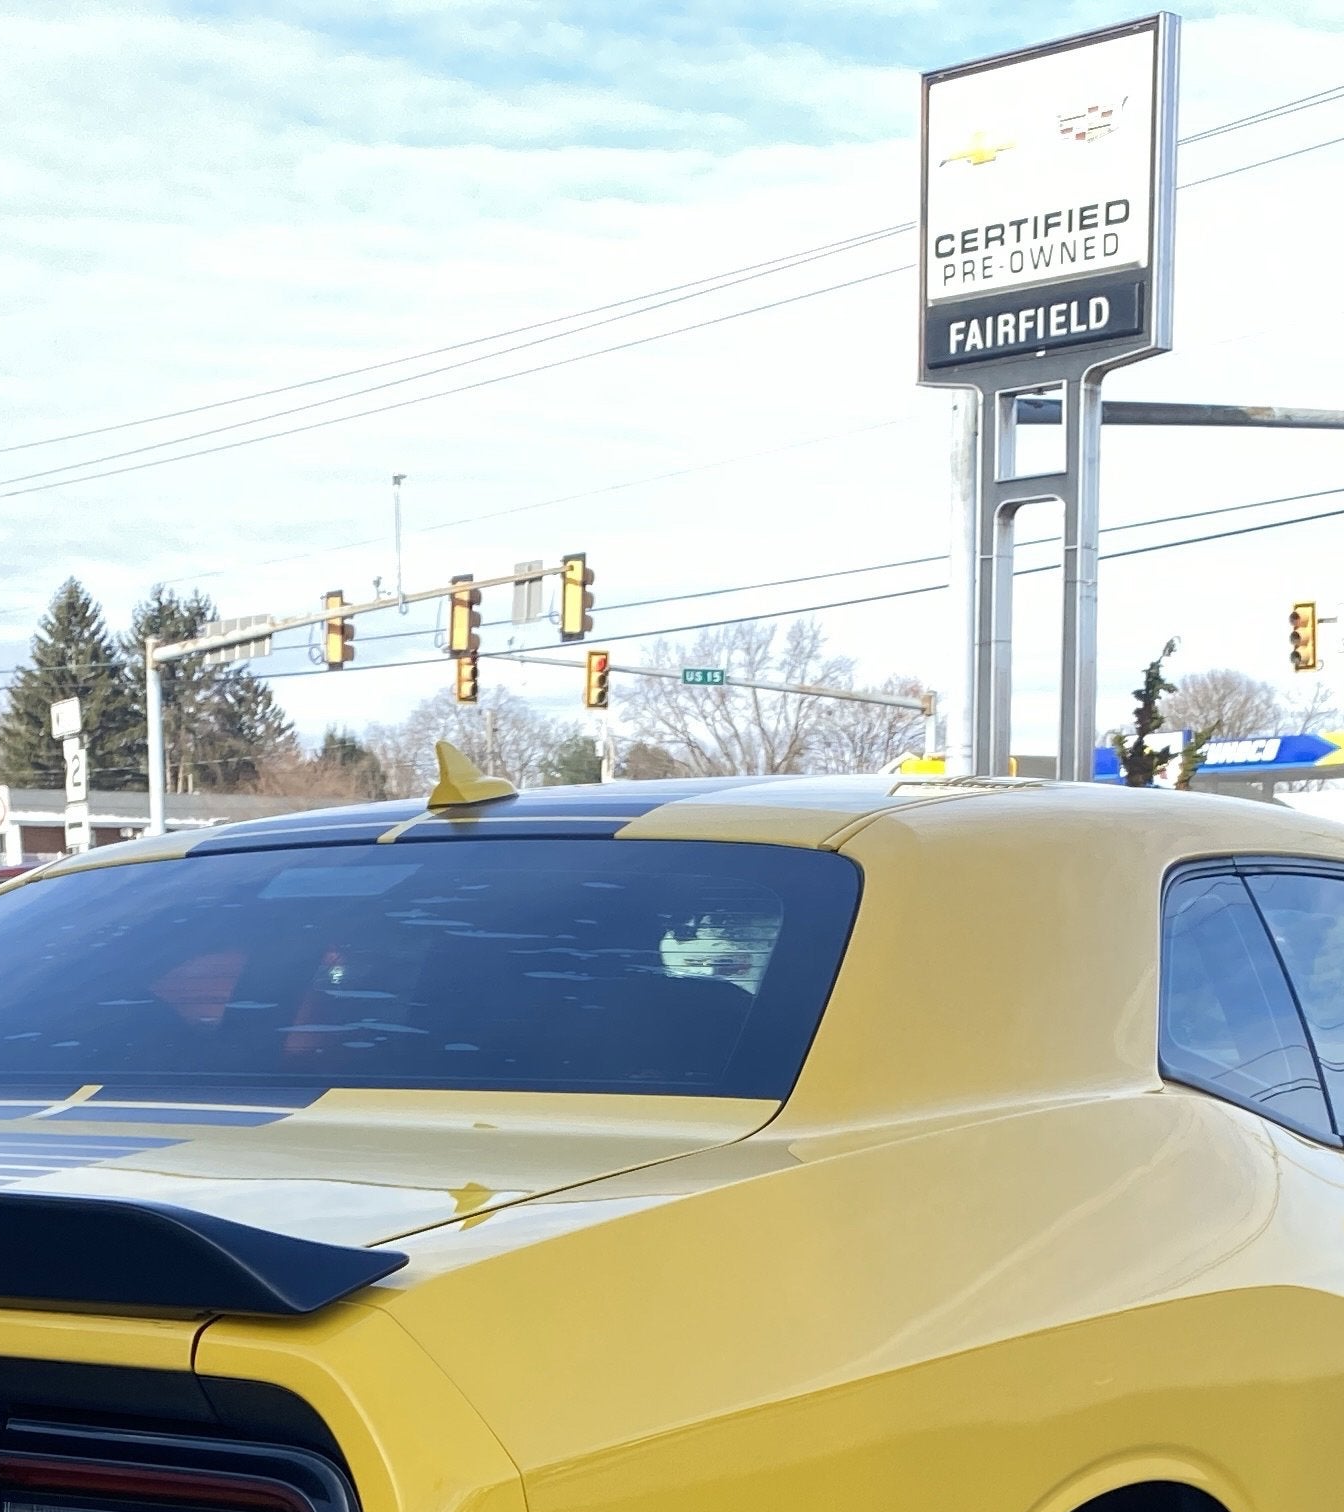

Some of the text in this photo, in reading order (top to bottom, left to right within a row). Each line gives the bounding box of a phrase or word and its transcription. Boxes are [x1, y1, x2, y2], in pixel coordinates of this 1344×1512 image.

[935, 199, 1131, 259] CERTIFIED
[943, 232, 1120, 287] PRE-OWNED
[949, 296, 1110, 355] FAIRFIELD
[686, 670, 722, 683] US 15
